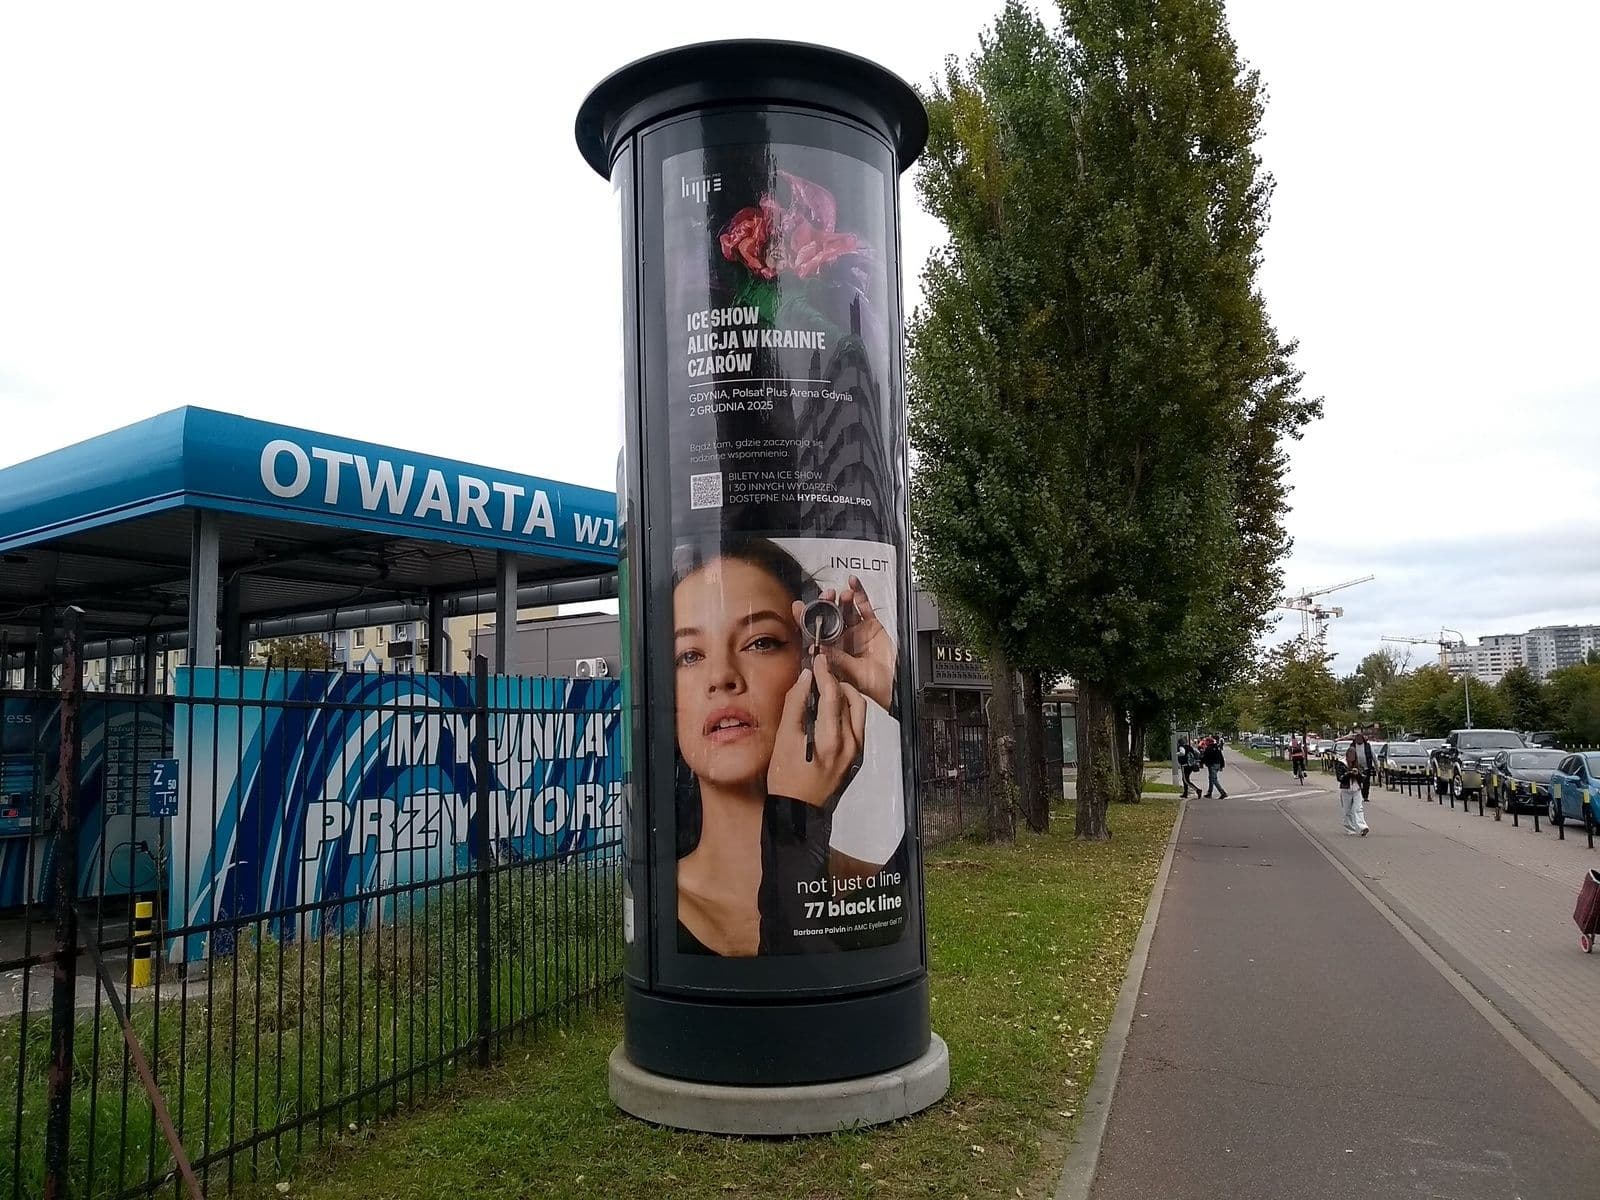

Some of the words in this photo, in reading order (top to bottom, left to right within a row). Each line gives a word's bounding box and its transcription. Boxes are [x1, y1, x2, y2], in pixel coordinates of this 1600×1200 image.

[687, 310, 709, 332] ICE
[710, 306, 760, 328] SHOW
[687, 331, 741, 355] ALICJA
[742, 329, 761, 349] W
[761, 329, 826, 350] KRAINIE
[687, 351, 752, 377] CZARÓW
[689, 389, 730, 403] GDYNIA,
[732, 388, 765, 398] Polsat
[766, 387, 788, 397] Plus
[789, 388, 820, 398] Arena
[821, 389, 853, 402] Gdynia
[689, 407, 696, 417] 2
[697, 402, 745, 415] GRUDNIA
[747, 400, 774, 411] 2025
[735, 438, 761, 450] gdzie
[728, 472, 760, 481] BILETY
[761, 471, 775, 480] NA
[777, 471, 792, 480] ICE
[794, 471, 823, 480] SHOW
[260, 439, 556, 538] OTWARTA
[573, 512, 618, 548] WJ
[733, 483, 747, 492] 30
[748, 482, 785, 491] INNYCH
[781, 493, 795, 502] NA
[797, 493, 872, 507] HYPEGLOBAL.PRO
[831, 556, 889, 572] INGLOT
[937, 646, 972, 662] MISS
[153, 769, 163, 786] Z
[797, 877, 828, 894] not
[832, 875, 862, 897] just
[866, 876, 875, 889] a
[880, 871, 901, 888] line
[804, 901, 825, 919] 77
[828, 897, 876, 918] black
[878, 893, 902, 912] line
[793, 926, 824, 936] Barbara
[825, 924, 847, 934] Palvin
[846, 925, 853, 933] in
